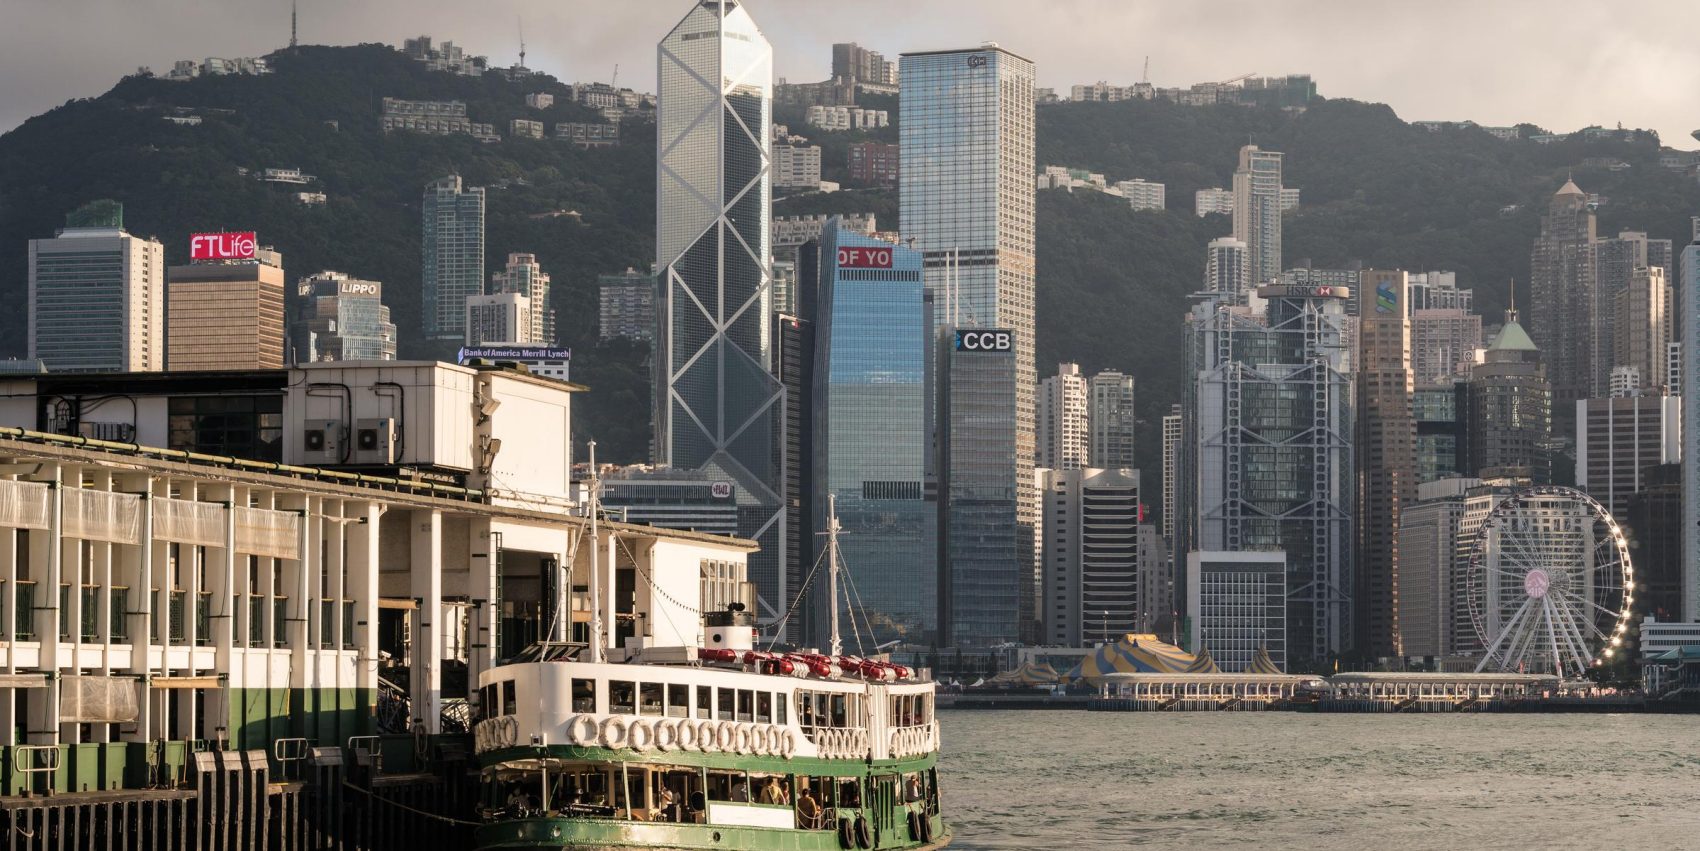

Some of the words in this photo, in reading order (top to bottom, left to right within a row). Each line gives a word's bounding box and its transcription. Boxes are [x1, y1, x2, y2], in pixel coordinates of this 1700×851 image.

[191, 235, 254, 257] FTLife
[838, 250, 859, 265] OF
[865, 250, 889, 265] YO
[341, 283, 377, 295] LIPPO
[1286, 286, 1315, 296] HSBC
[964, 332, 1010, 350] CCB
[464, 348, 484, 357] Bank
[483, 348, 491, 357] of
[491, 349, 521, 357] America
[522, 349, 546, 357] Merrill
[547, 349, 569, 358] Lynch
